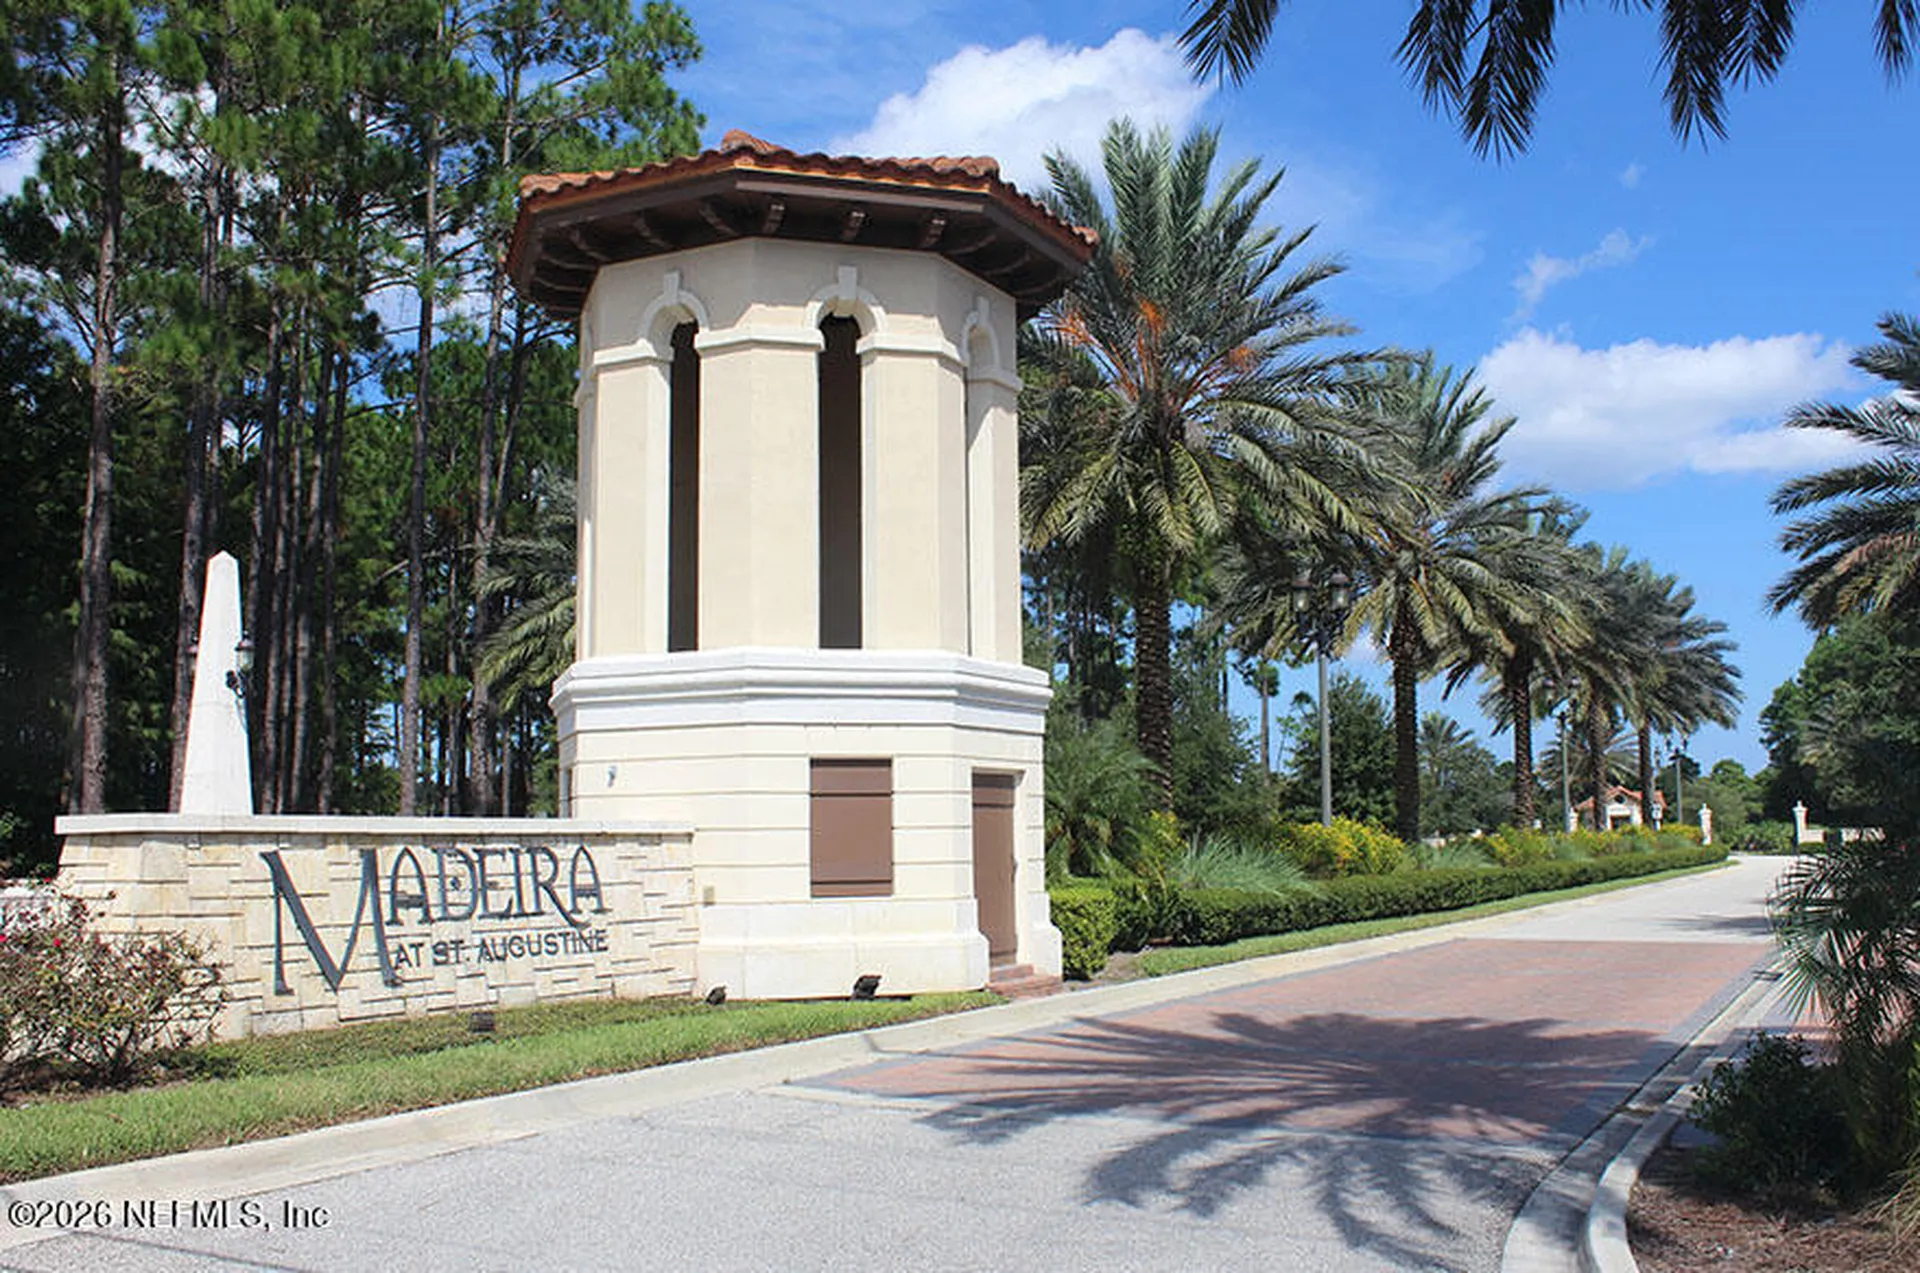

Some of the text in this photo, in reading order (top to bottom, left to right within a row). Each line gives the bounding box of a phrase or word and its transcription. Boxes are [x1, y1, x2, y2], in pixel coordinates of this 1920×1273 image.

[260, 845, 614, 996] MADEIRA
[394, 929, 610, 969] AT ST. AUGUSTINE
